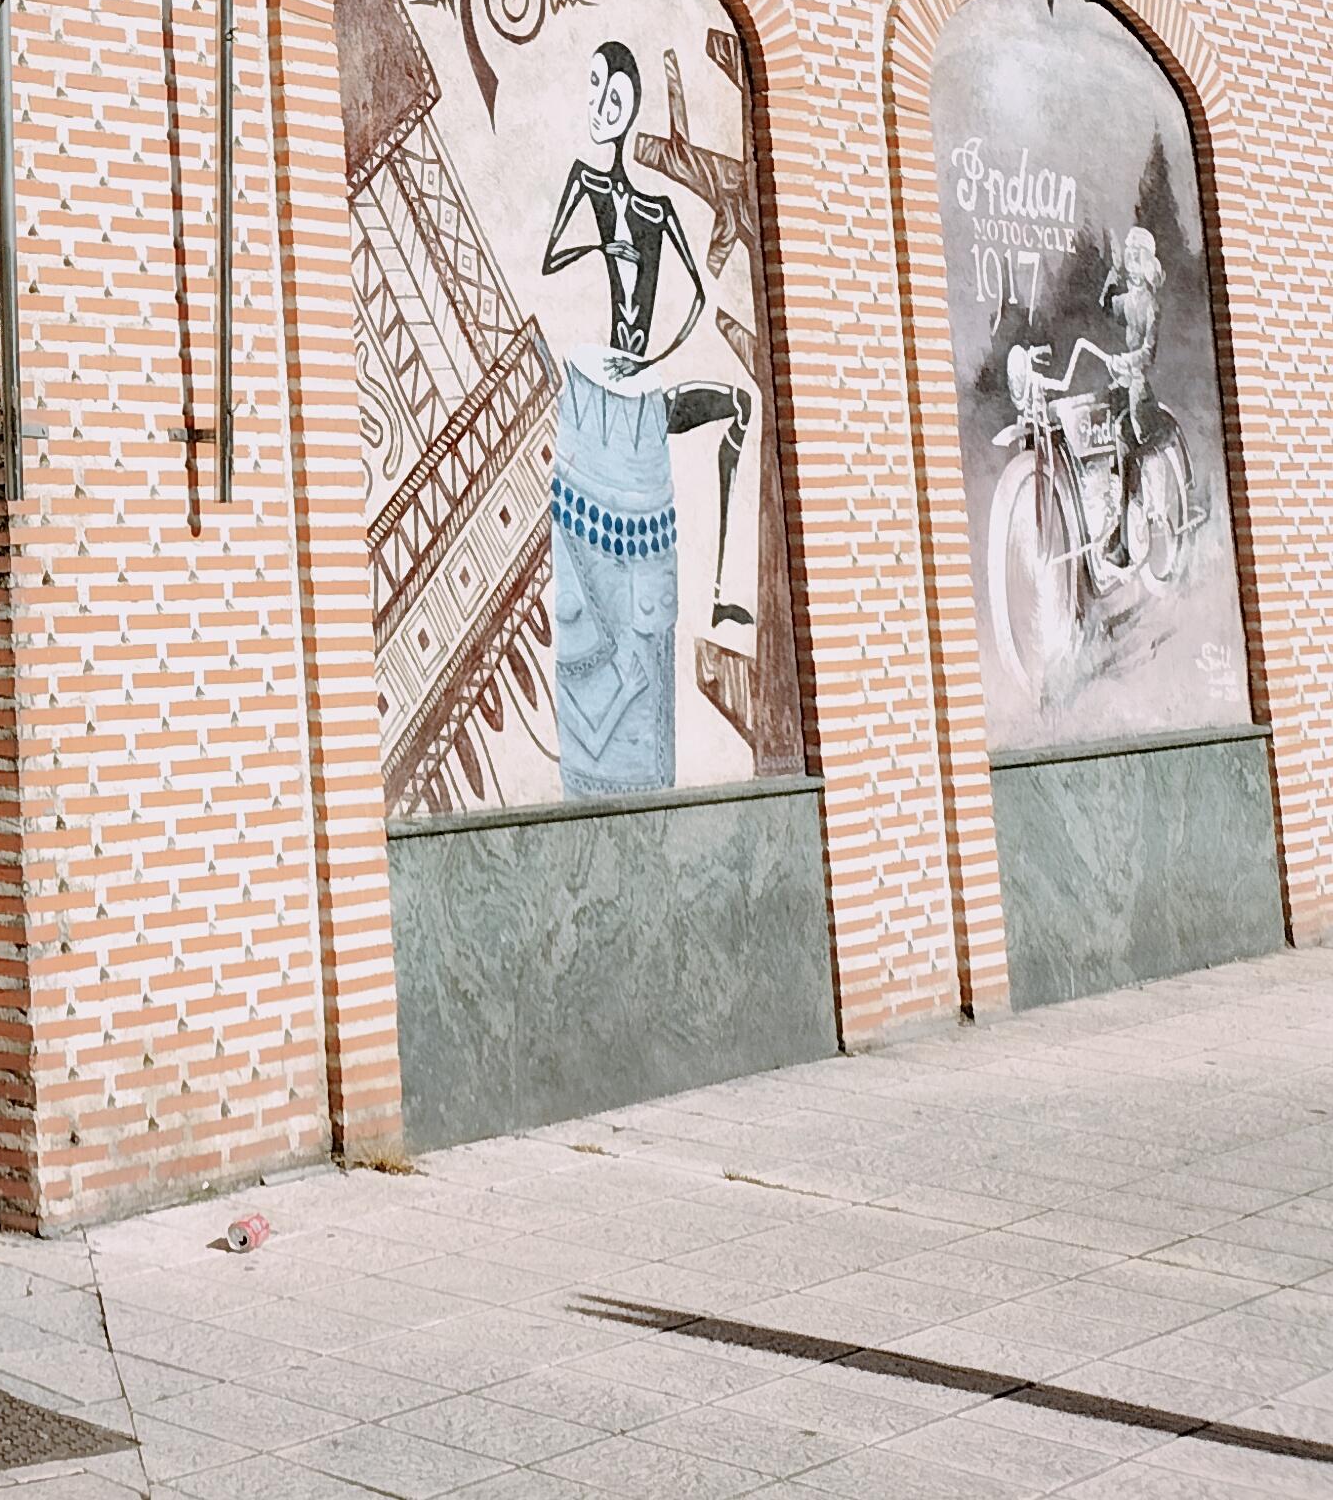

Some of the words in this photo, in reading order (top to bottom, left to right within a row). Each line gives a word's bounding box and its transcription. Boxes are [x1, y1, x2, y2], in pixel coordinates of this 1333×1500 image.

[951, 137, 1076, 223] Indian
[973, 217, 1076, 253] MOTOCYCLE
[971, 244, 1040, 336] 1917
